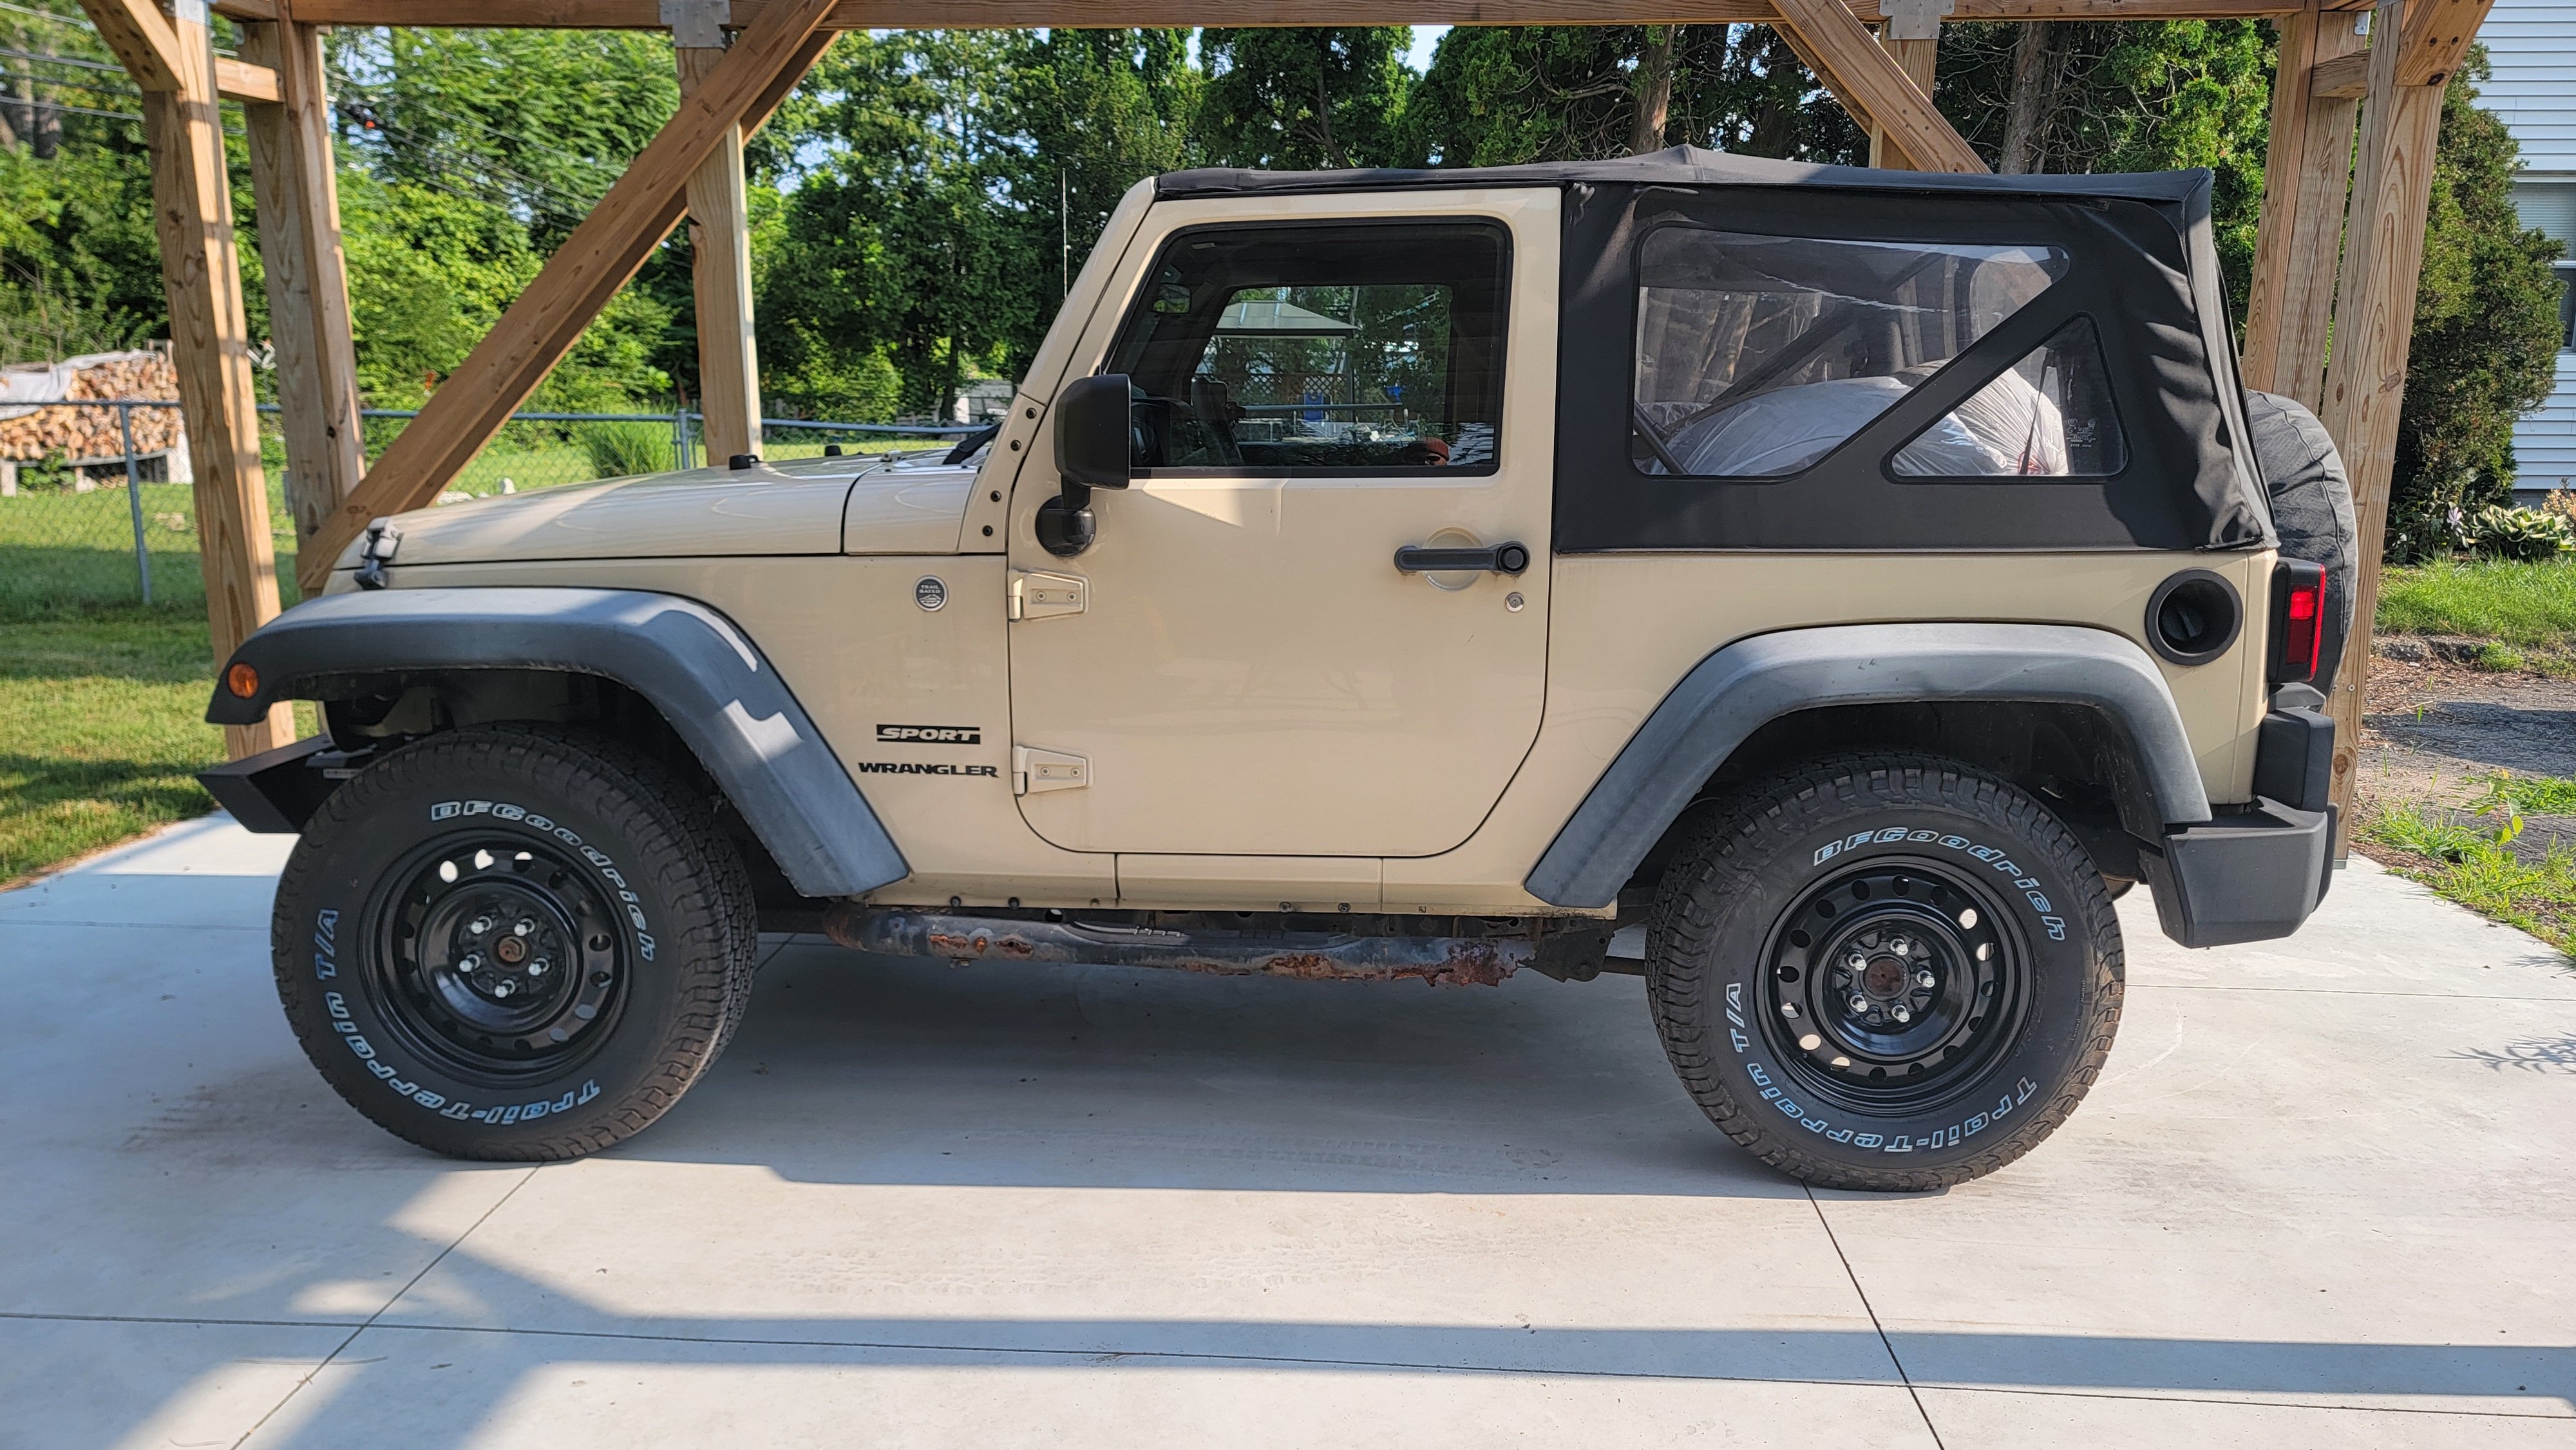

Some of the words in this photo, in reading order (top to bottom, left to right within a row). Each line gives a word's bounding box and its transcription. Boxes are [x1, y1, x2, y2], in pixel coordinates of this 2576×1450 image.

[858, 762, 999, 778] WRANGLER
[878, 727, 980, 741] SPORT
[431, 800, 656, 962] BFGoodrich
[1813, 826, 2066, 942] BFGoodrich
[315, 909, 339, 981] T/A
[325, 990, 601, 1126] Trail-Terrain
[1725, 982, 1750, 1054] T/A
[1746, 1062, 2038, 1152] Trail-Terrain
